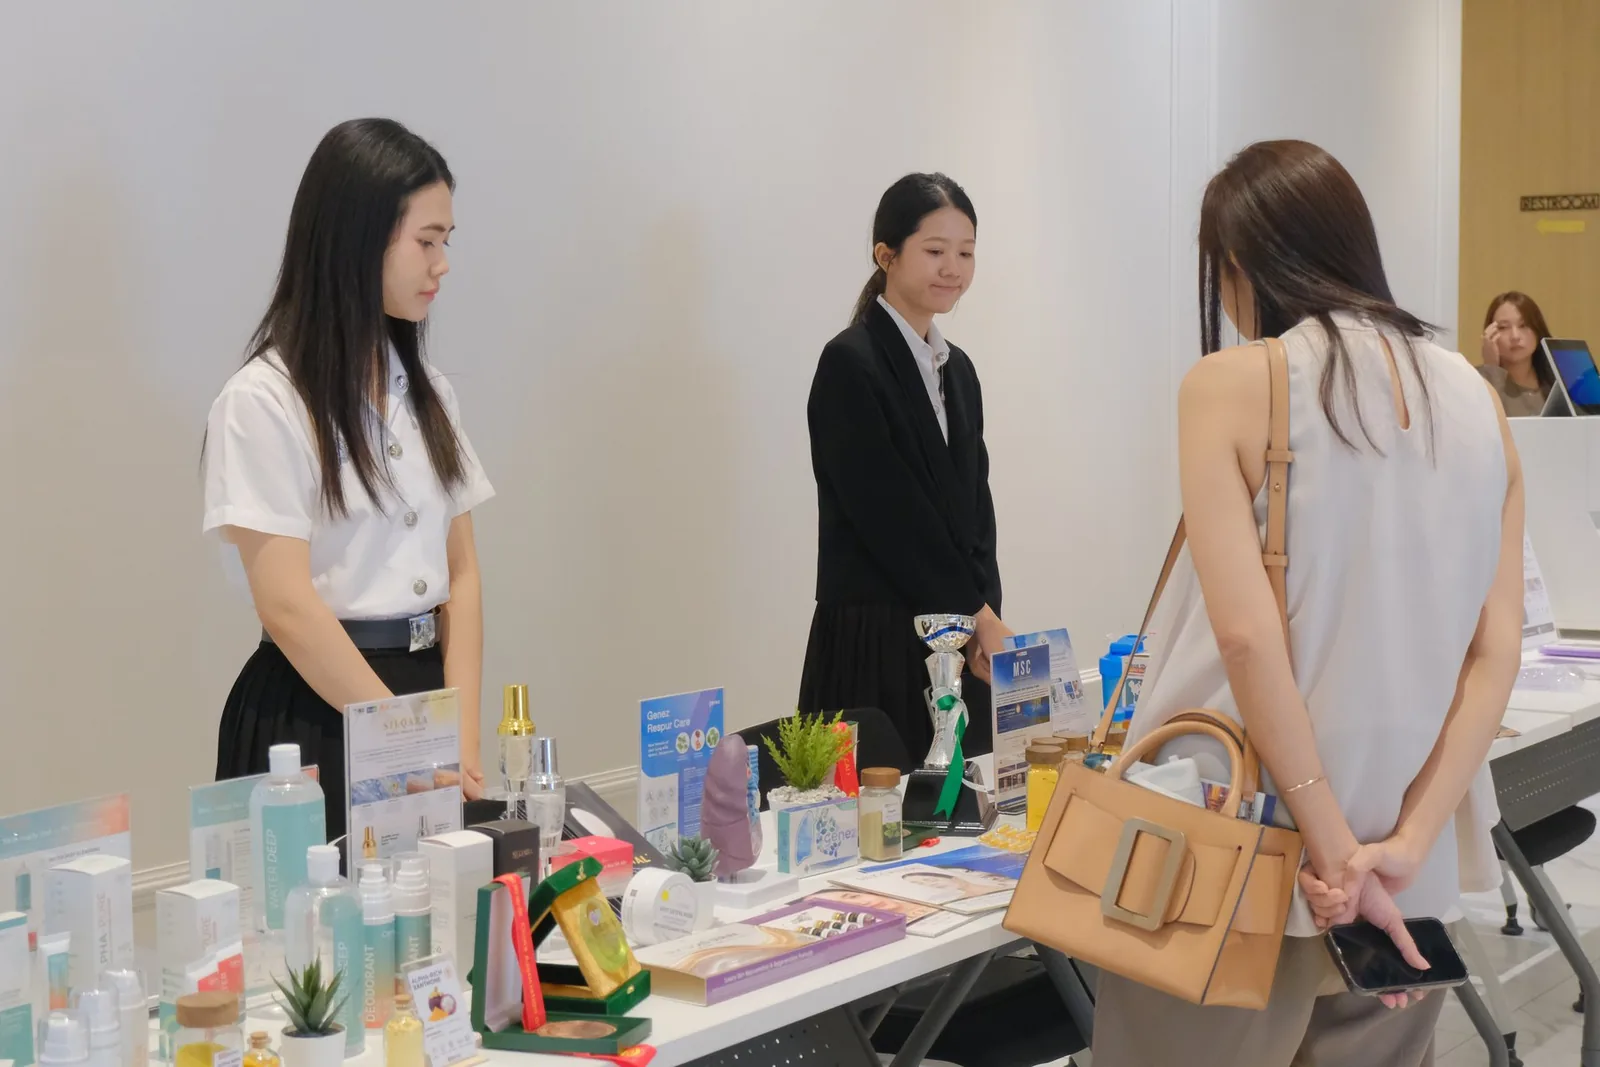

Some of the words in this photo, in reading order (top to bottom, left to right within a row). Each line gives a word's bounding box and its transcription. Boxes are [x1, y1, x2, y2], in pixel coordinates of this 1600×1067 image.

[1521, 193, 1599, 211] RESTROOM
[1013, 659, 1031, 677] MSC
[647, 710, 670, 720] Genez
[647, 722, 673, 733] Respur
[673, 718, 691, 729] Care
[265, 828, 277, 863] DEEP
[824, 828, 857, 845] genez
[363, 944, 376, 1022] DEODORANT
